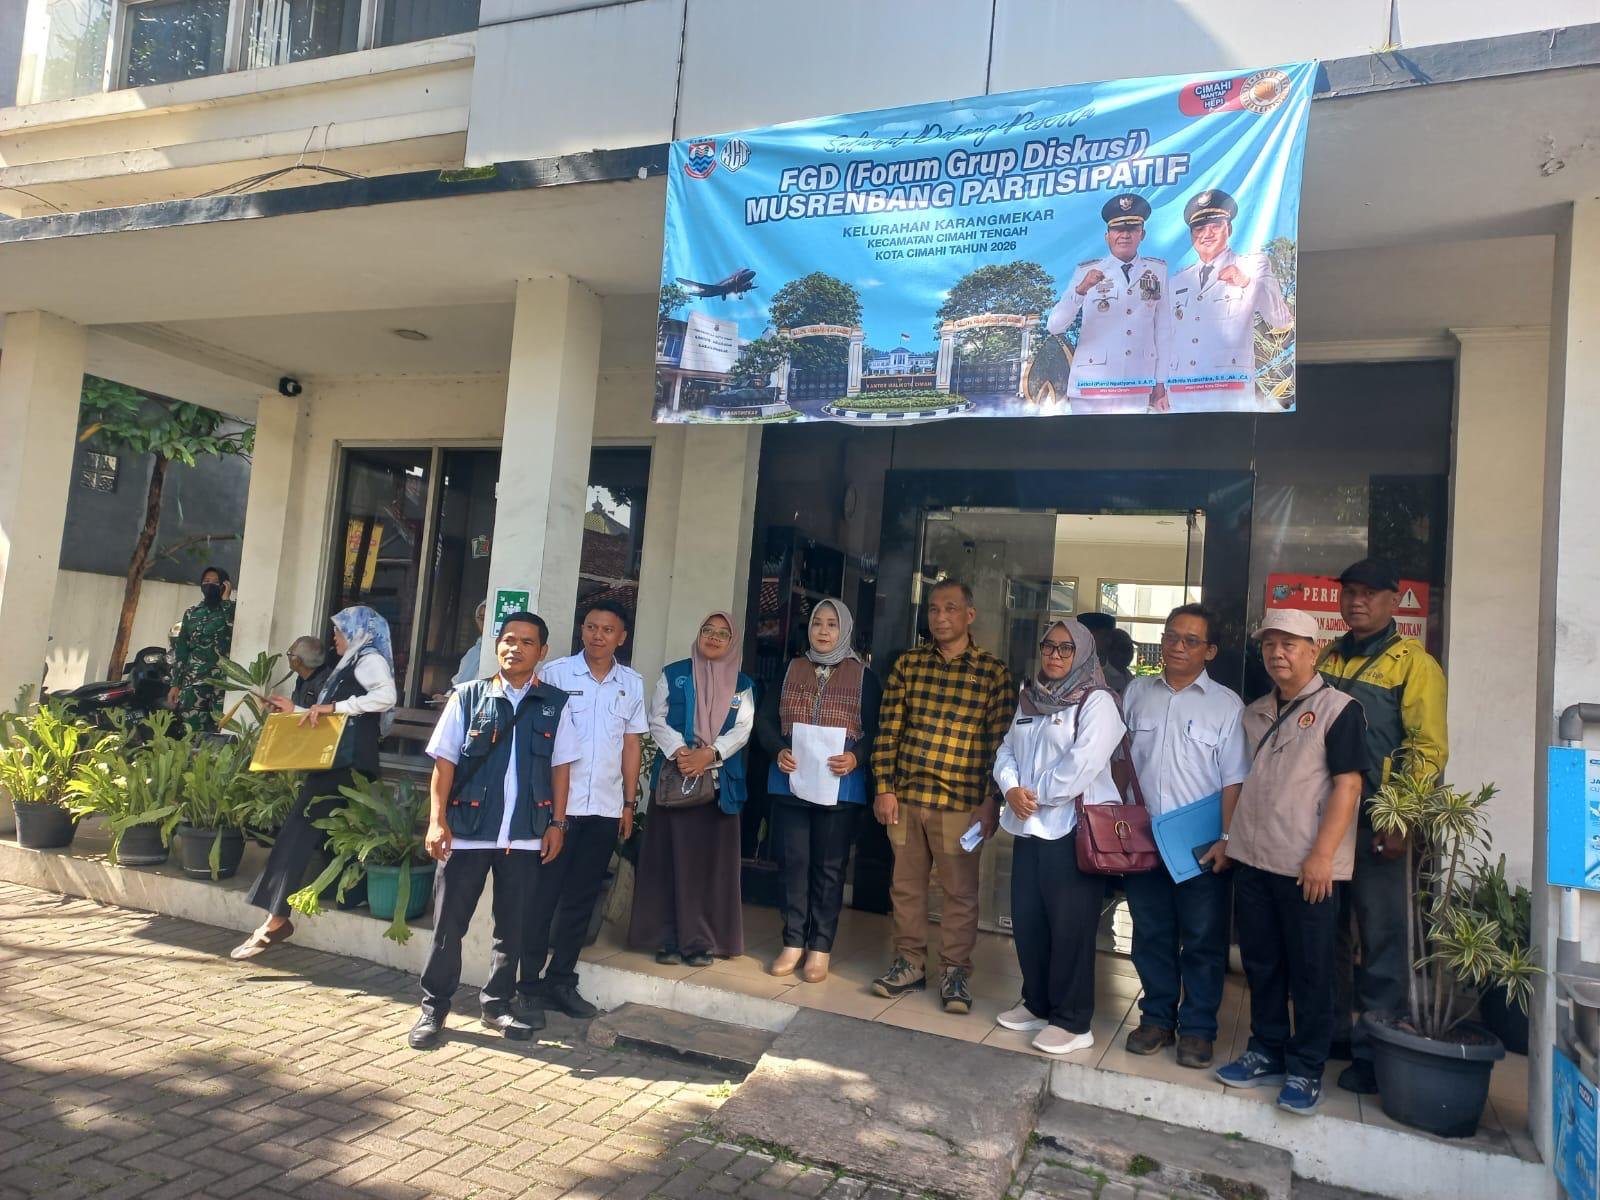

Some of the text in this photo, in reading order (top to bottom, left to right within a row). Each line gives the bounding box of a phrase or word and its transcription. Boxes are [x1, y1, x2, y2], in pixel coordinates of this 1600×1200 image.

[1194, 80, 1232, 95] CIMAHI
[1200, 90, 1227, 100] MANTAP
[1204, 99, 1224, 108] HEPI
[823, 108, 1096, 154] Selamat Datang Peserta
[779, 129, 1149, 193] FGD (Forum Grup Diskusi)
[745, 154, 1190, 225] MUSRENBANG PARTISIPATIF
[842, 208, 1055, 238] KELURAHAN KARANGMEKAR
[867, 226, 1028, 249] KECAMATAN CIMAHI TENGAH
[875, 241, 1017, 261] KOTA CIMAHI TAHUN 2026
[1303, 586, 1339, 603] PERH
